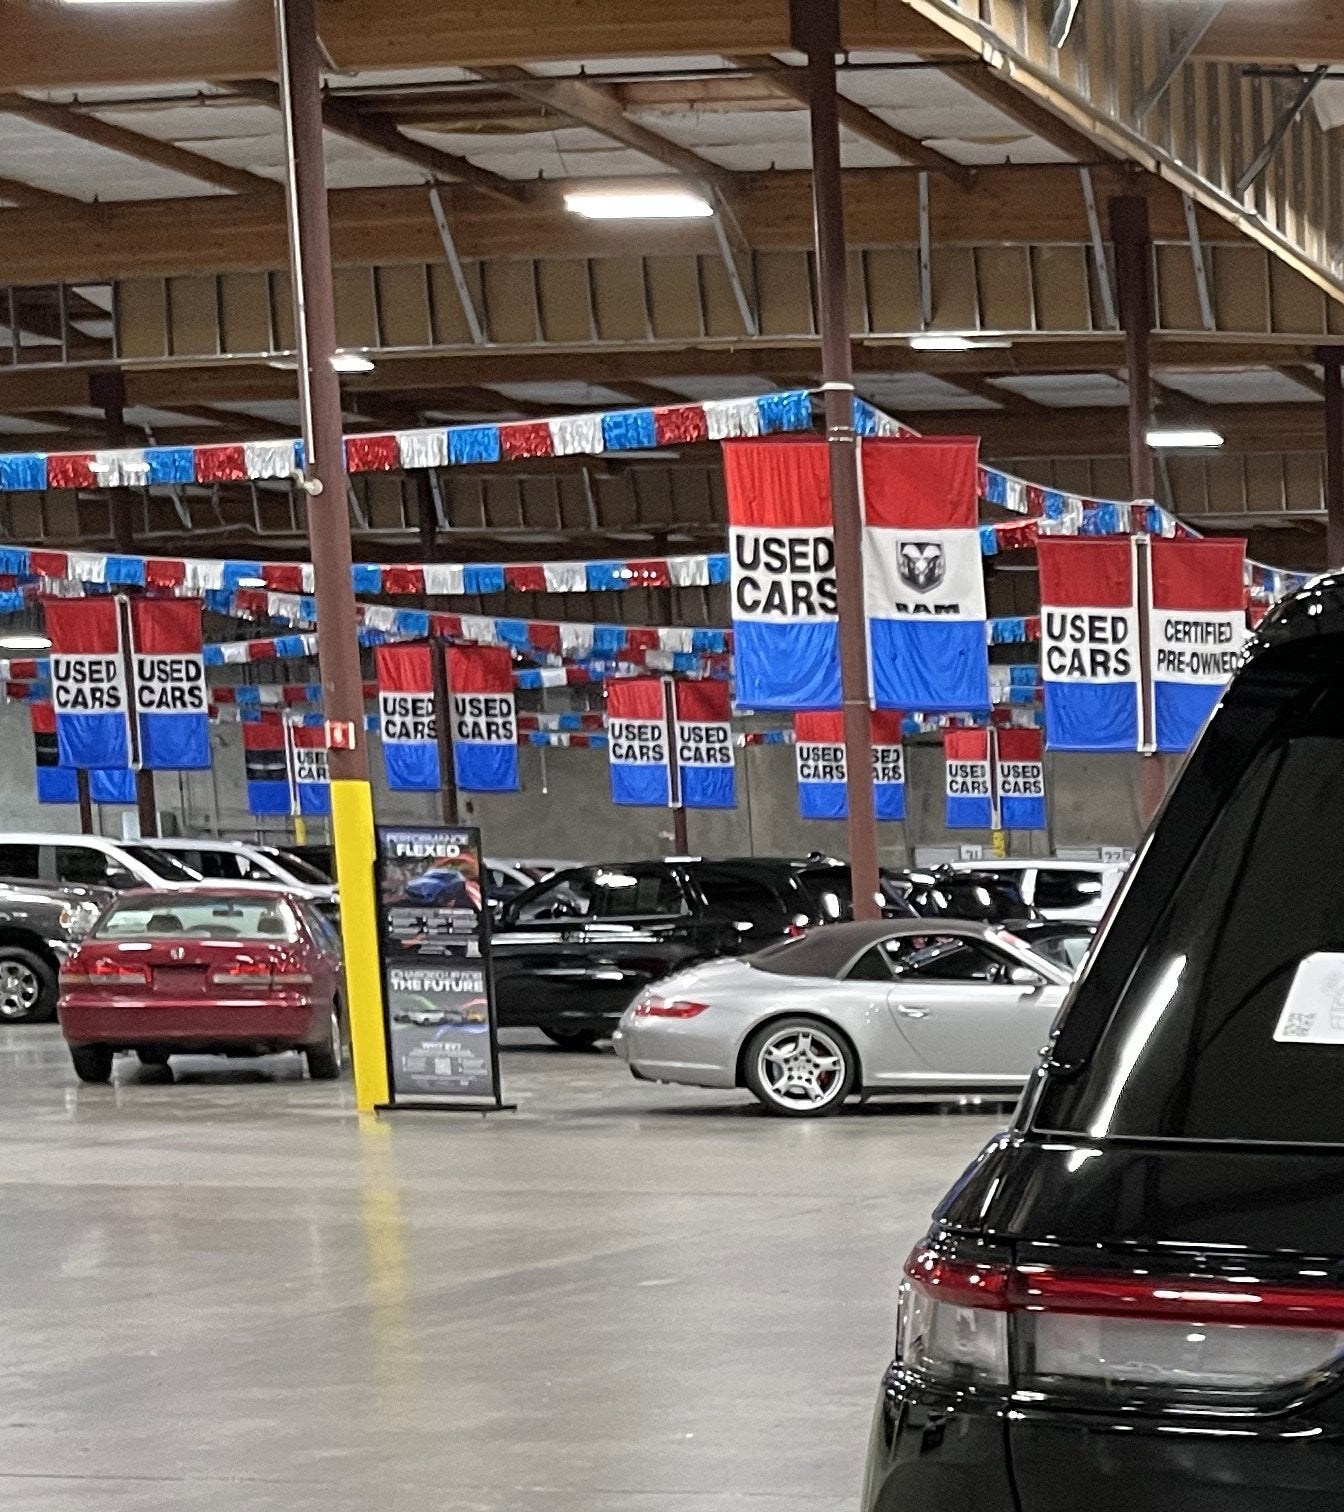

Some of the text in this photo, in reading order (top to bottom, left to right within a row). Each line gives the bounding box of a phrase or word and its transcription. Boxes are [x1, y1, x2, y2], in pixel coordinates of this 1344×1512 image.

[736, 534, 834, 574] USED
[736, 576, 838, 616] CARS
[895, 602, 960, 615] RAM
[1046, 612, 1128, 645] USED
[1164, 619, 1233, 645] CERTIFIED
[1047, 645, 1131, 677] CARS
[1157, 649, 1240, 675] PRE-OWNED
[53, 659, 116, 683] USED
[137, 659, 201, 683] USED
[55, 685, 121, 709] CARS
[138, 685, 203, 709] CARS
[383, 696, 435, 717] USED
[455, 697, 512, 718] USED
[385, 719, 438, 740] CARS
[458, 720, 513, 740] CARS
[611, 723, 662, 742] USED
[680, 726, 728, 744] USED
[612, 743, 664, 762] CARS
[680, 745, 731, 763] CARS
[800, 746, 844, 763] USED
[872, 748, 900, 764] SED
[298, 766, 327, 779] CAR
[800, 763, 846, 780] CARS
[1000, 764, 1040, 779] USED
[949, 779, 989, 794] CARS
[1001, 780, 1041, 794] CARS
[396, 843, 460, 858] FLEXED
[391, 979, 484, 993] THE FUTURE
